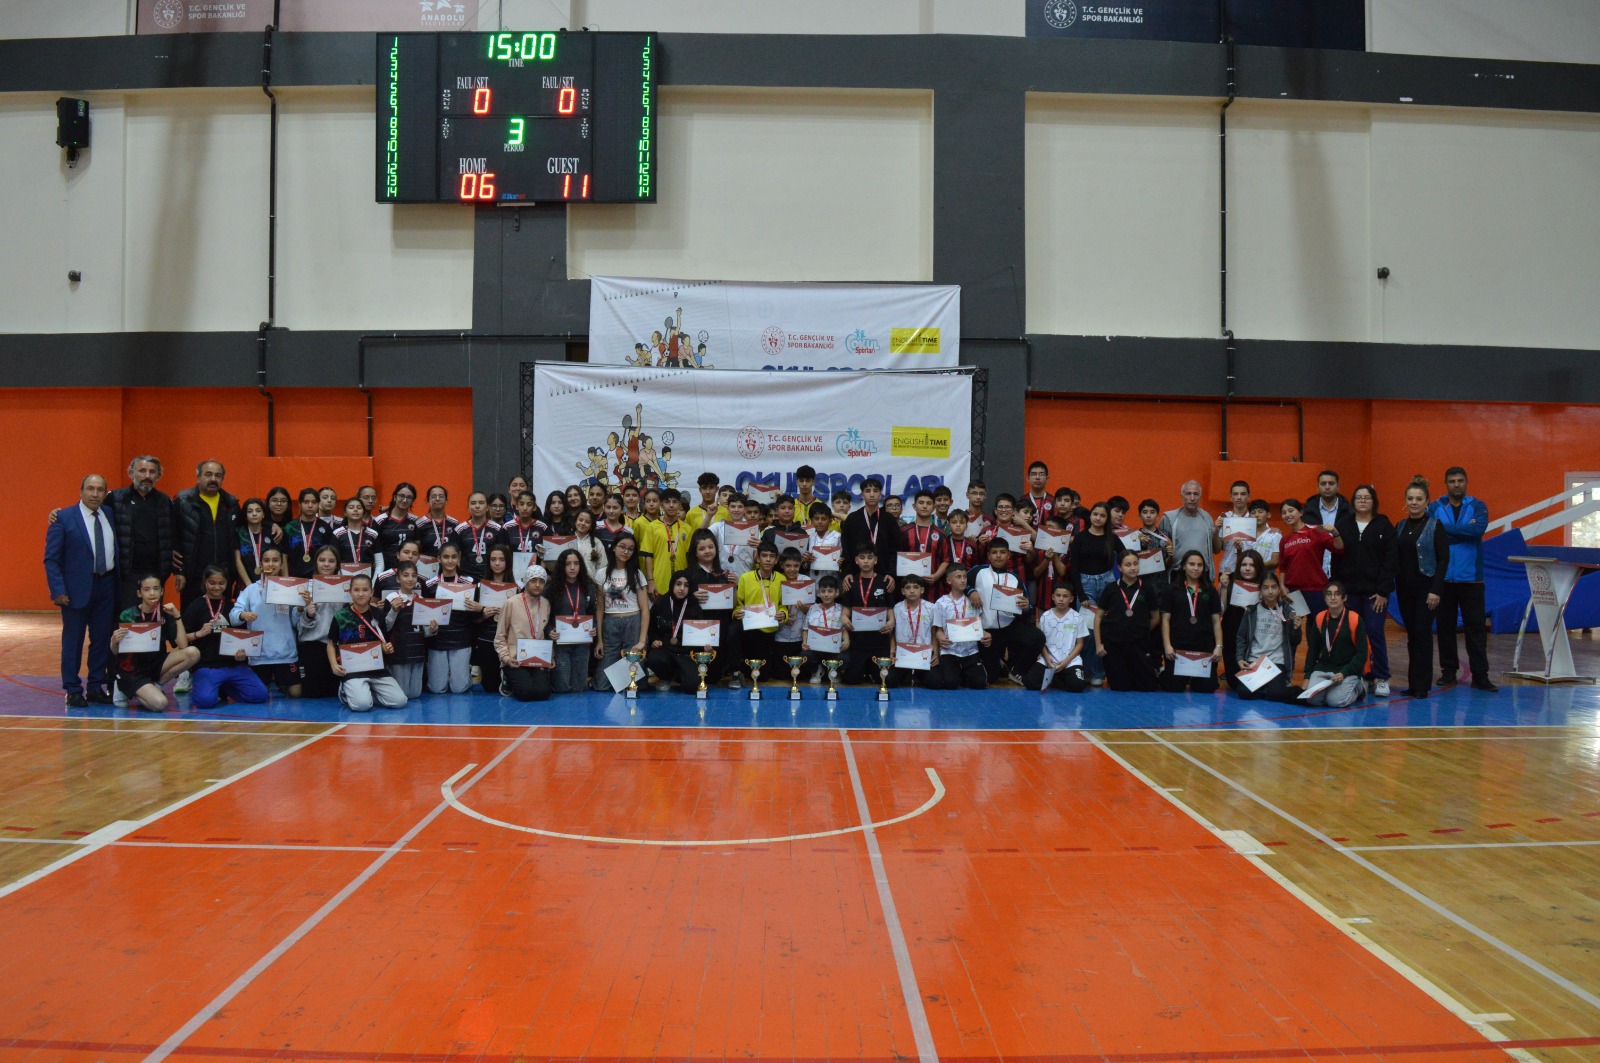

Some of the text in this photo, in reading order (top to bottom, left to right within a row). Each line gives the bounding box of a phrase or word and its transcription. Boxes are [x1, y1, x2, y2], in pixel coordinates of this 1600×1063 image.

[1098, 6, 1131, 15] GENÇLİK
[1104, 15, 1144, 24] BAKANLIĞI
[488, 34, 556, 60] 15:00
[391, 48, 398, 59] 2
[643, 48, 650, 58] 2
[391, 60, 398, 70] 3
[508, 59, 524, 67] TIME
[643, 59, 650, 70] 3
[391, 72, 398, 82] 4
[643, 71, 650, 81] 4
[391, 82, 397, 94] 5
[457, 76, 489, 89] FAUL/SET
[542, 76, 574, 89] FAUL/SET
[643, 82, 649, 93] 5
[390, 94, 397, 105] 6
[474, 88, 490, 113] 0
[559, 88, 575, 113] 0
[643, 94, 649, 104] 6
[391, 106, 397, 116] 7
[643, 105, 649, 115] 7
[390, 117, 397, 128] 8
[643, 116, 649, 128] 8
[390, 129, 397, 140] 9
[508, 118, 524, 144] 3
[643, 129, 649, 139] 9
[388, 140, 397, 152] 10
[503, 143, 524, 152] PERIOD
[639, 140, 649, 151] 10
[388, 152, 397, 162] 11
[639, 152, 649, 162] 11
[388, 163, 397, 174] 12
[459, 158, 487, 174] HOME
[547, 157, 579, 174] GUEST
[639, 163, 649, 174] 12
[388, 175, 397, 186] 13
[460, 173, 495, 199] 06
[564, 174, 589, 198] 11
[639, 175, 649, 186] 13
[388, 187, 397, 197] 14
[639, 187, 649, 197] 14
[782, 434, 812, 444] GENÇLİK
[894, 437, 924, 446] ENGLISH
[787, 444, 823, 452] BAKANLIĞI
[358, 624, 365, 638] 5
